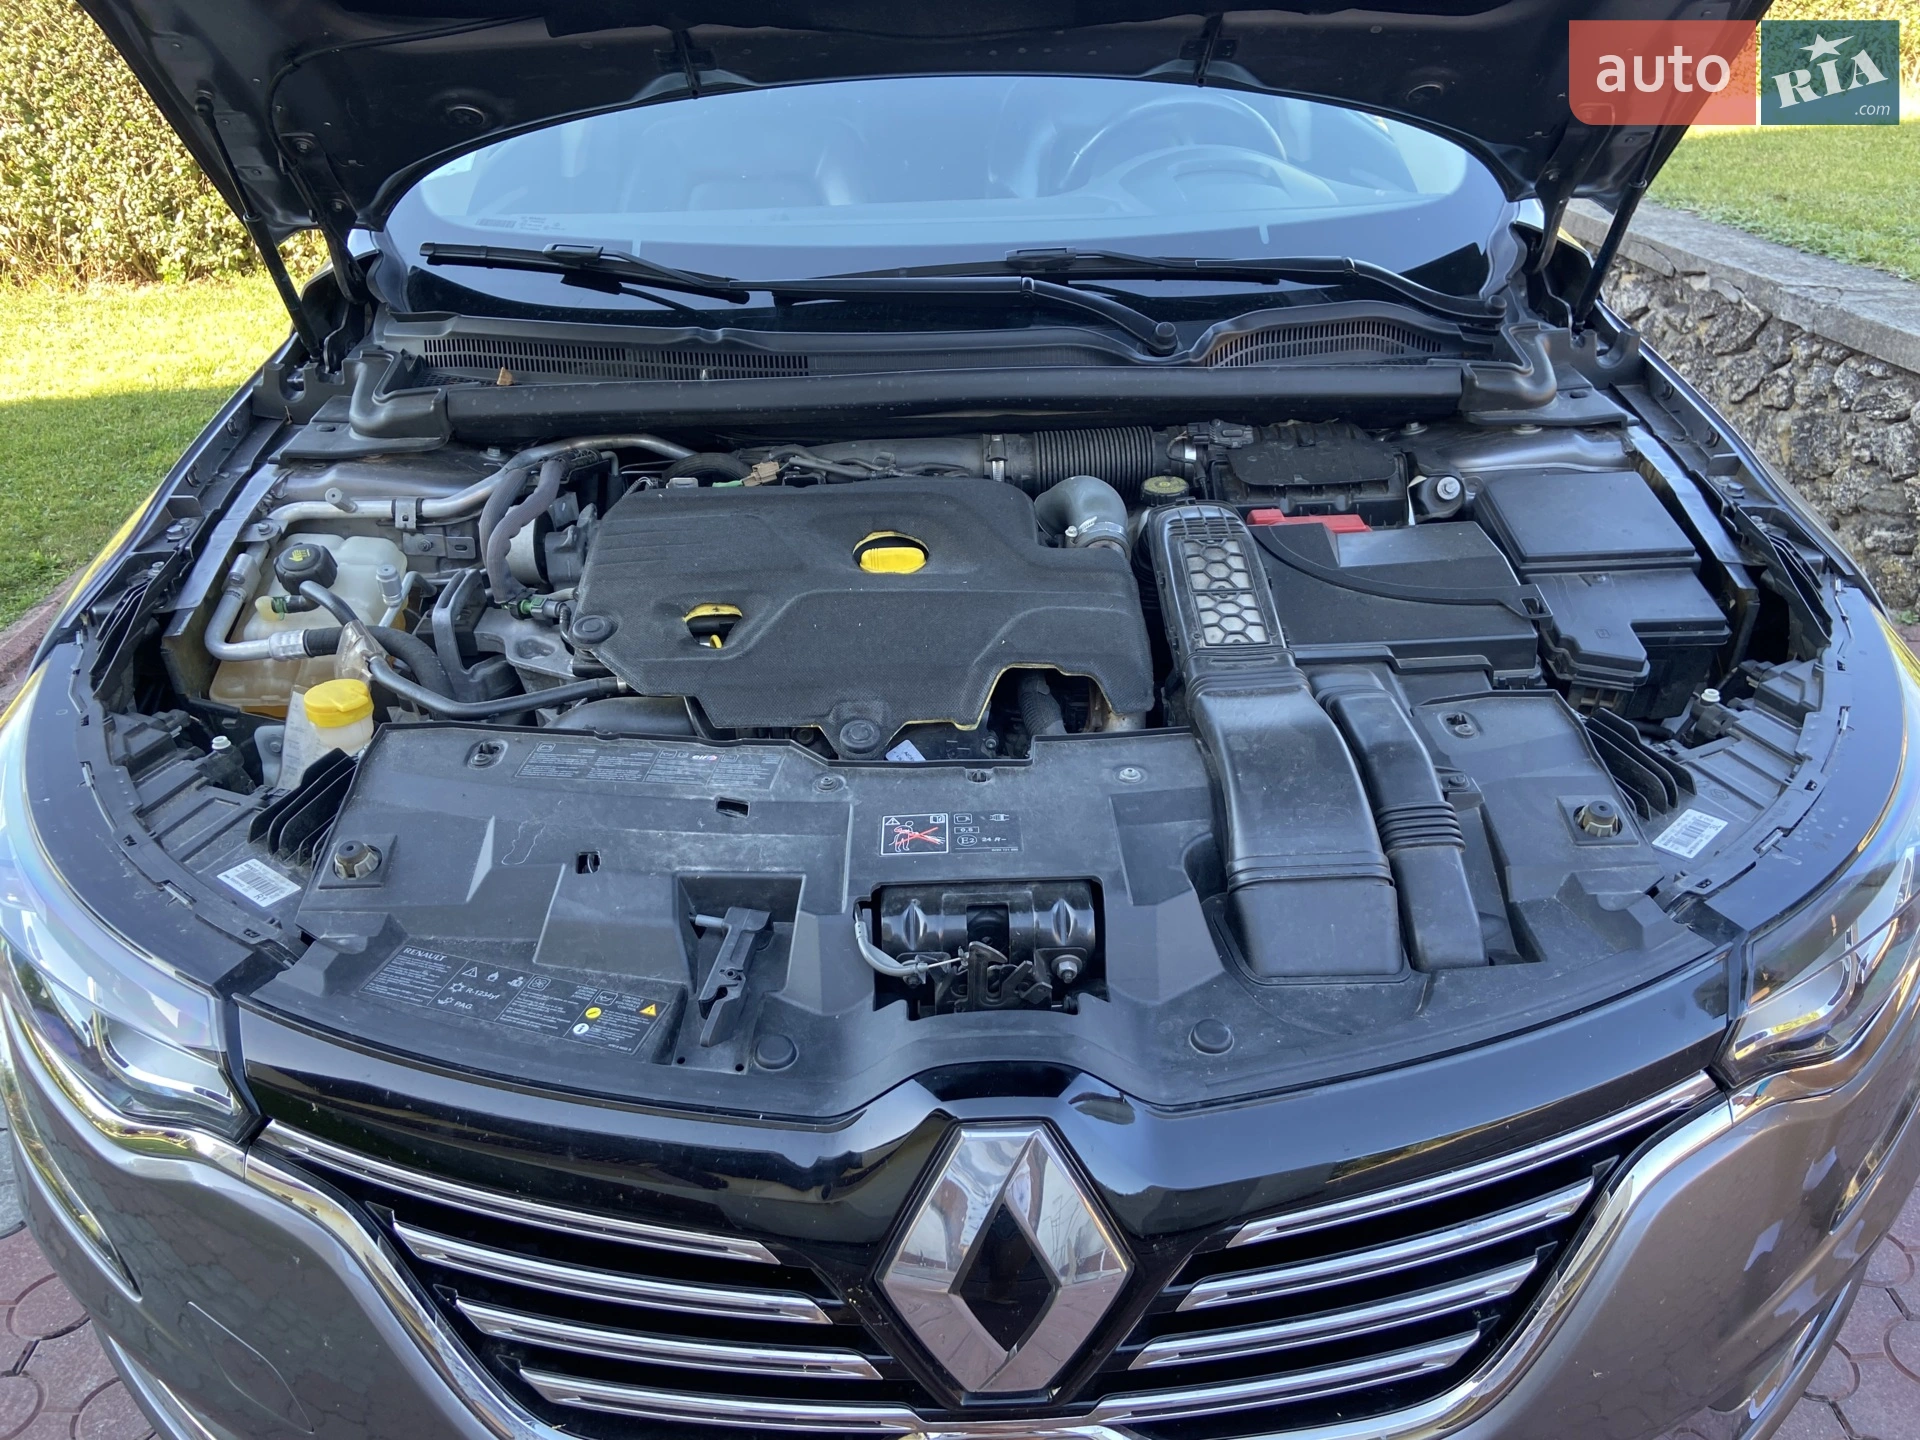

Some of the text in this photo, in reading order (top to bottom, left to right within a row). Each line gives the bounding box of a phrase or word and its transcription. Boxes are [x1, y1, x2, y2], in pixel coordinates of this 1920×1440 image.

[402, 947, 448, 962] RENAULT
[465, 987, 501, 1000] R-1234yf
[453, 1001, 473, 1010] PAG
